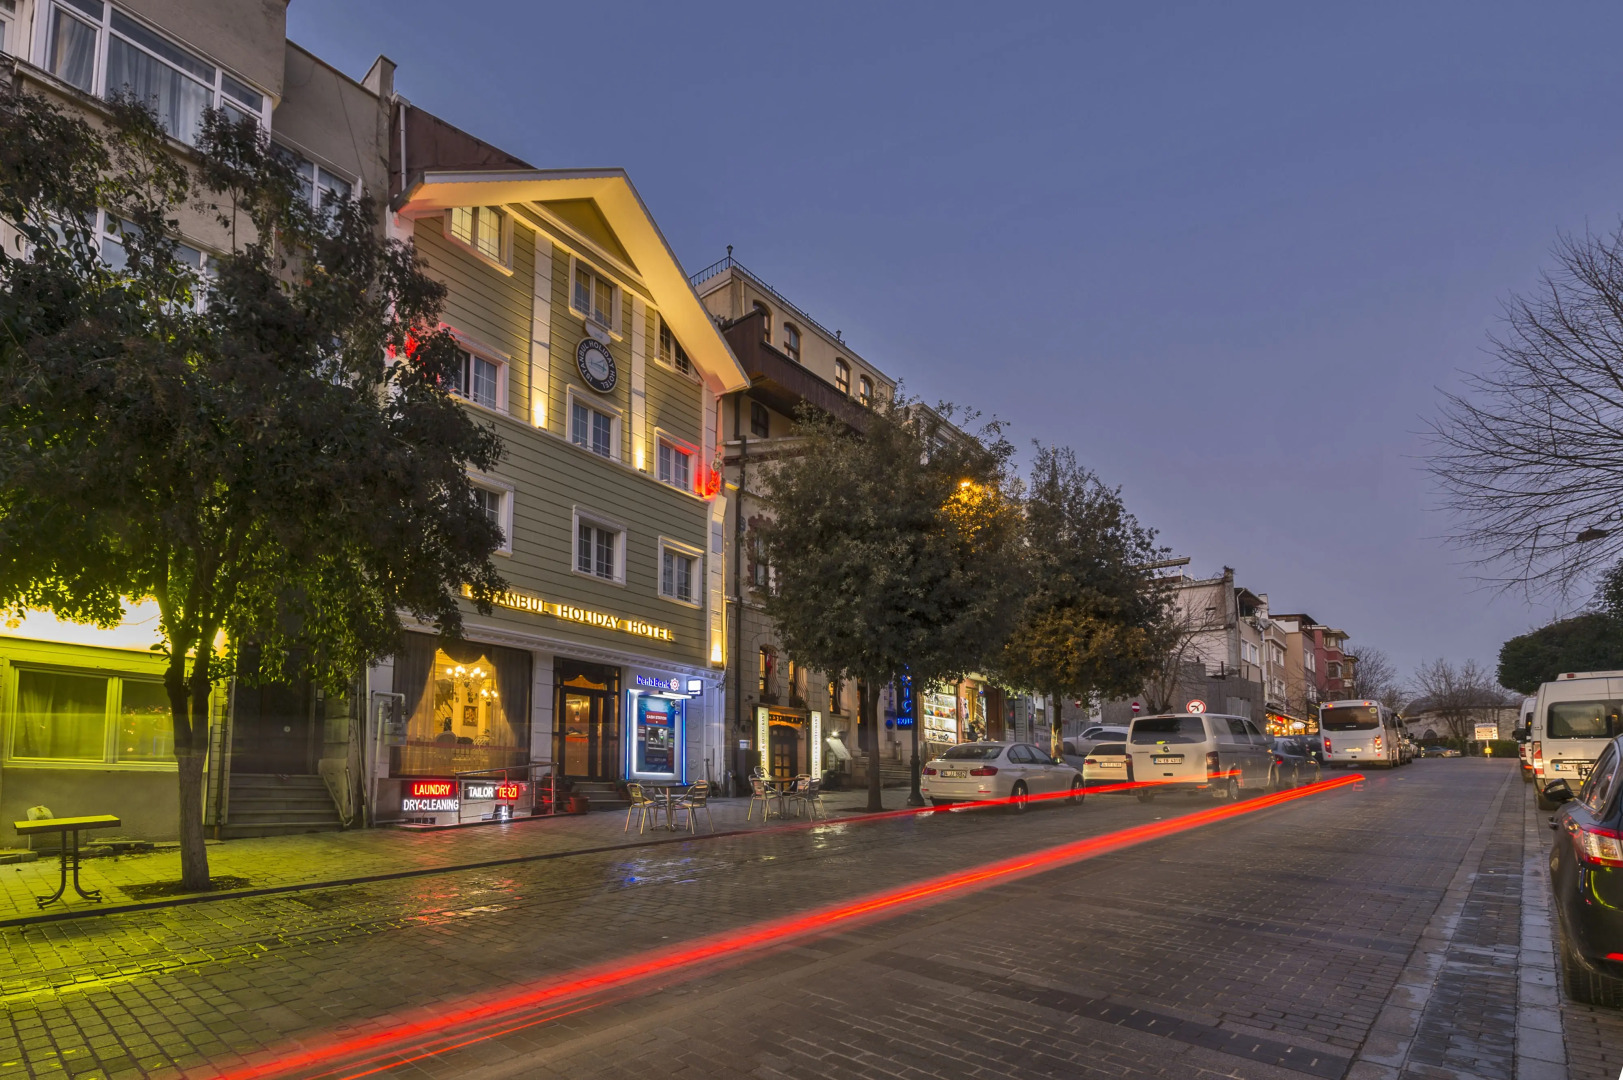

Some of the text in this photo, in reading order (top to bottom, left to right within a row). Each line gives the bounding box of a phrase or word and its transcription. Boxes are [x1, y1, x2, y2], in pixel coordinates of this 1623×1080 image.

[588, 340, 615, 369] HOLIDAY
[600, 371, 615, 388] HOTEL
[559, 603, 621, 630] HOLIDAY
[630, 620, 674, 642] HOTEL
[413, 783, 451, 796] LAUNDRY
[468, 786, 494, 798] TAILOR
[403, 798, 459, 811] DRY-CLEANING
